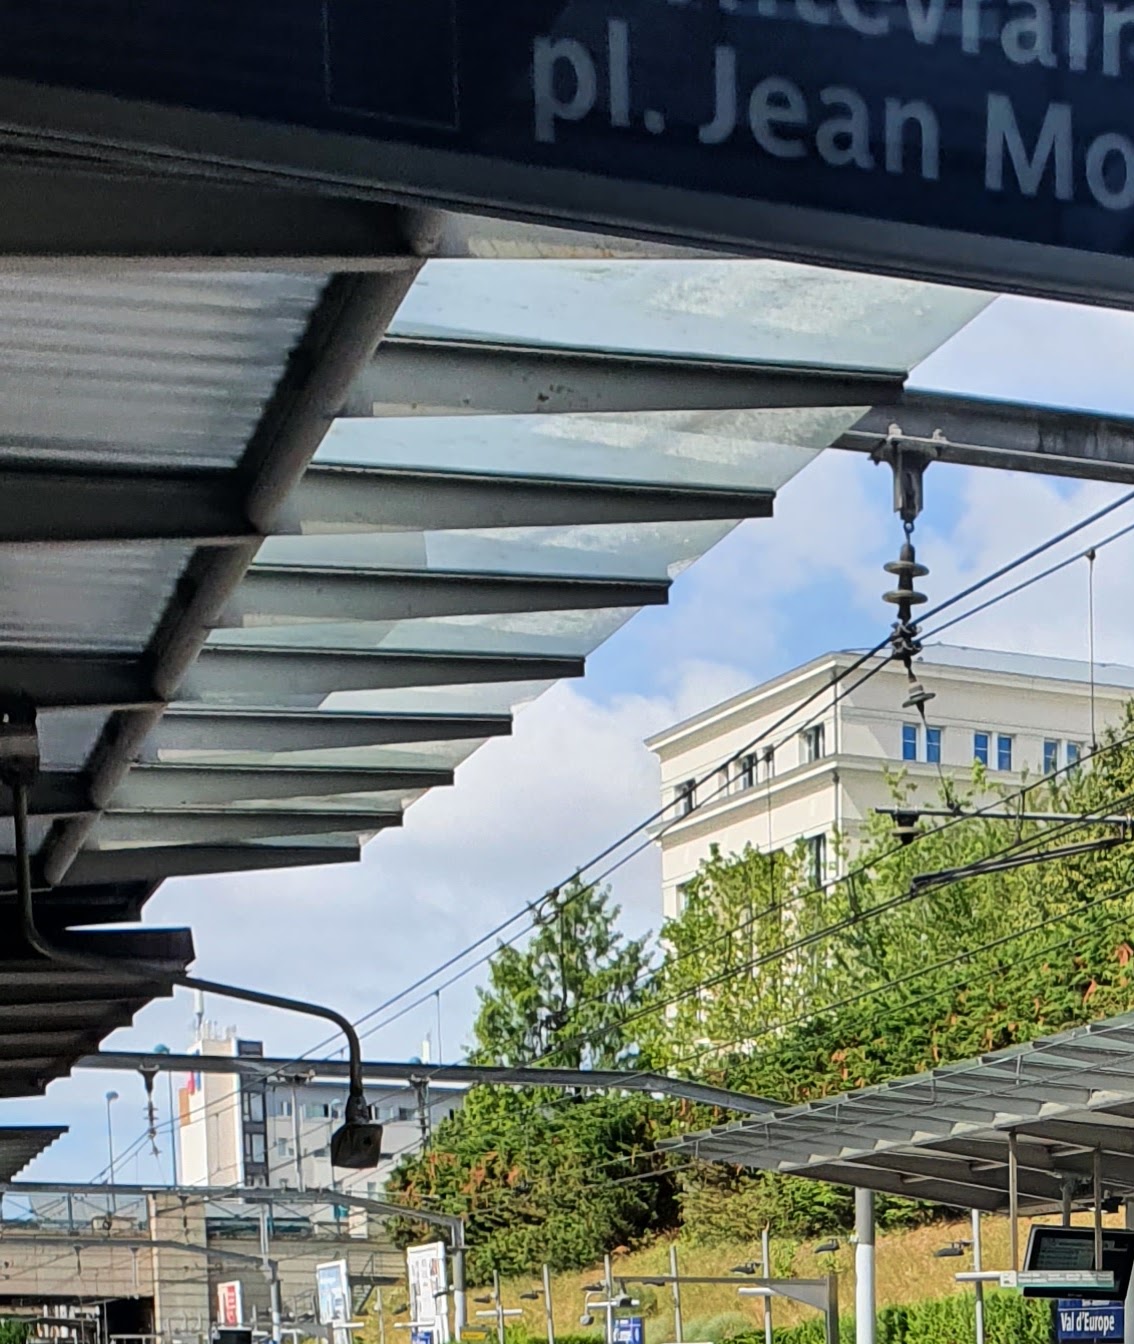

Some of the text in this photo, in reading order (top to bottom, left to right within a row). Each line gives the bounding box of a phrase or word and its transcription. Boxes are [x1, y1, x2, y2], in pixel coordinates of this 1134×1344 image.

[532, 17, 666, 143] pl.
[699, 45, 940, 181] Jean
[1060, 1311, 1116, 1336] Val d'Europe
